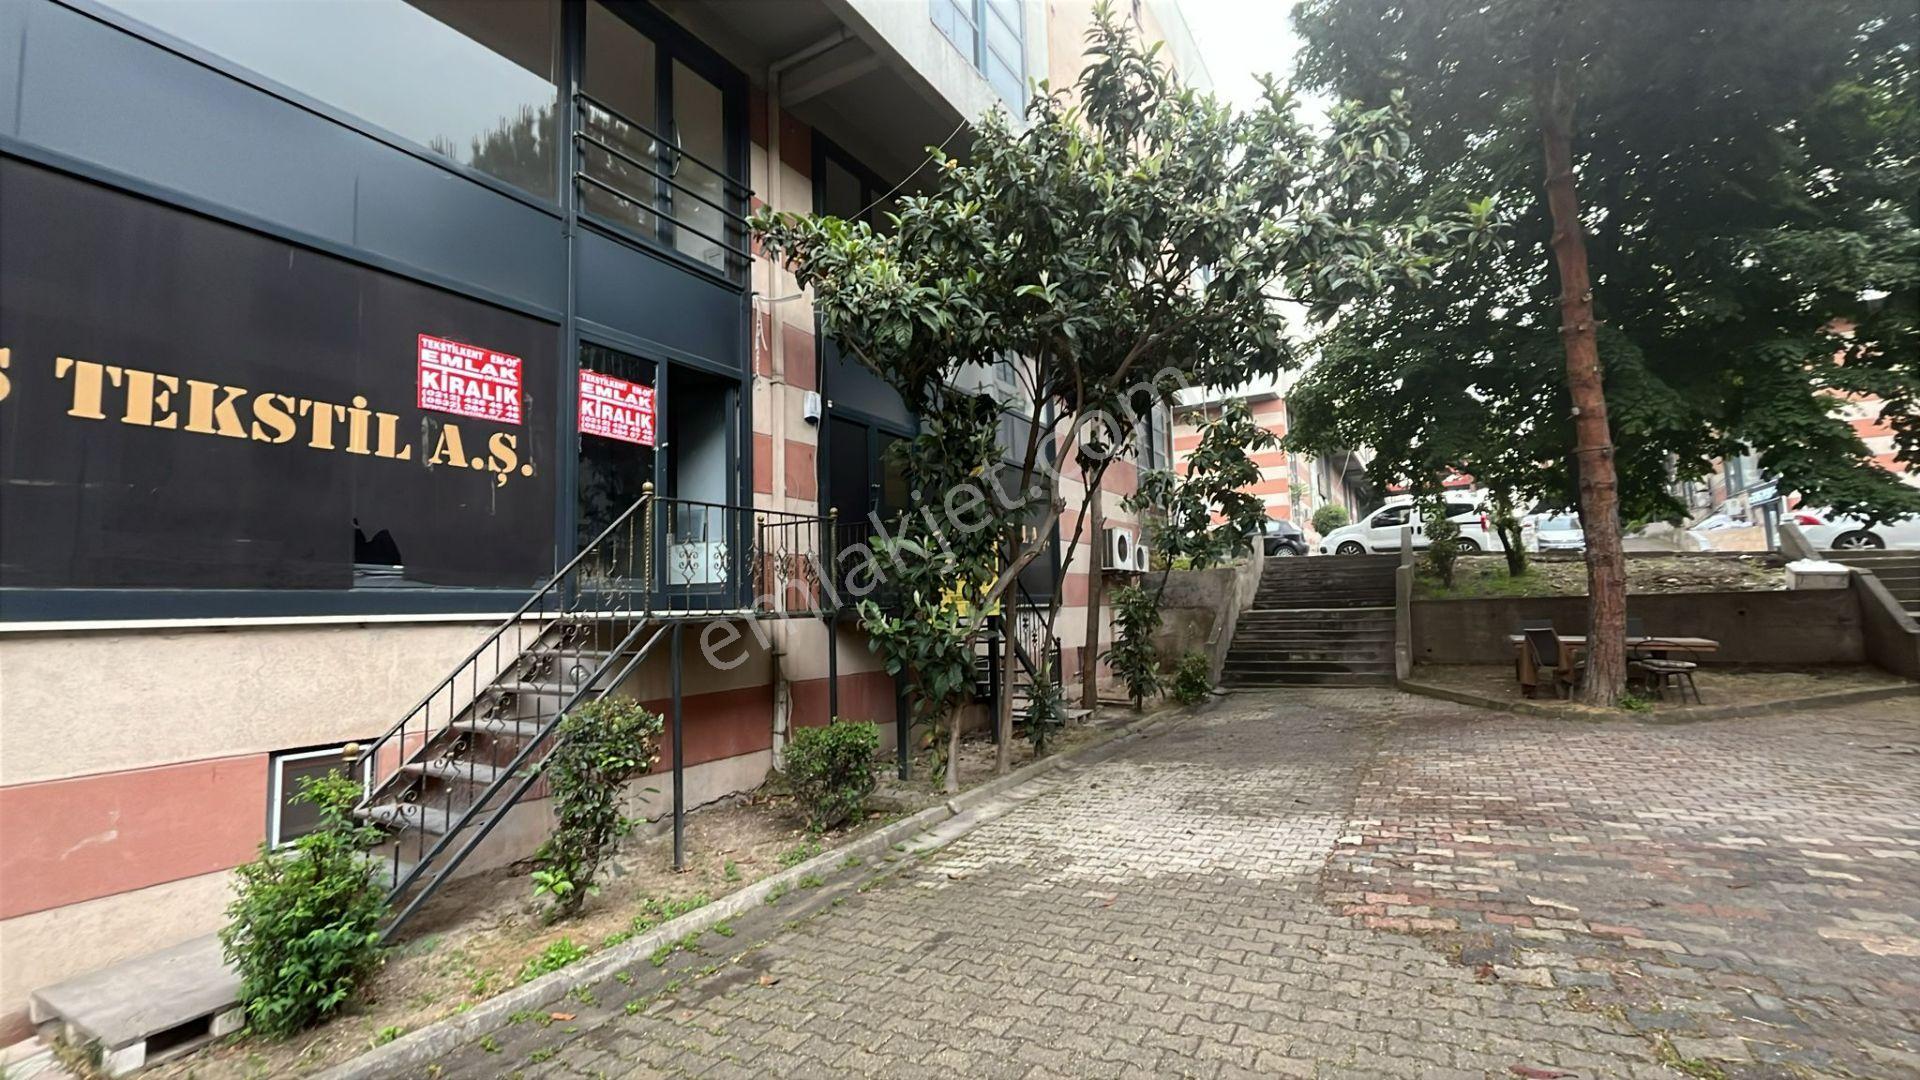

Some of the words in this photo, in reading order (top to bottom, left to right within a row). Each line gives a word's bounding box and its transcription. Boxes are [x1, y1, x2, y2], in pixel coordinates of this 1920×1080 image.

[421, 338, 484, 360] TEKSTİLKENT
[421, 349, 518, 380] EMLAK
[422, 368, 518, 406] KİRALIK
[581, 382, 652, 408] EMLAK
[55, 357, 411, 460] TEKSTİL
[428, 423, 533, 487] A.Ş.
[581, 400, 652, 430] KİRALIK
